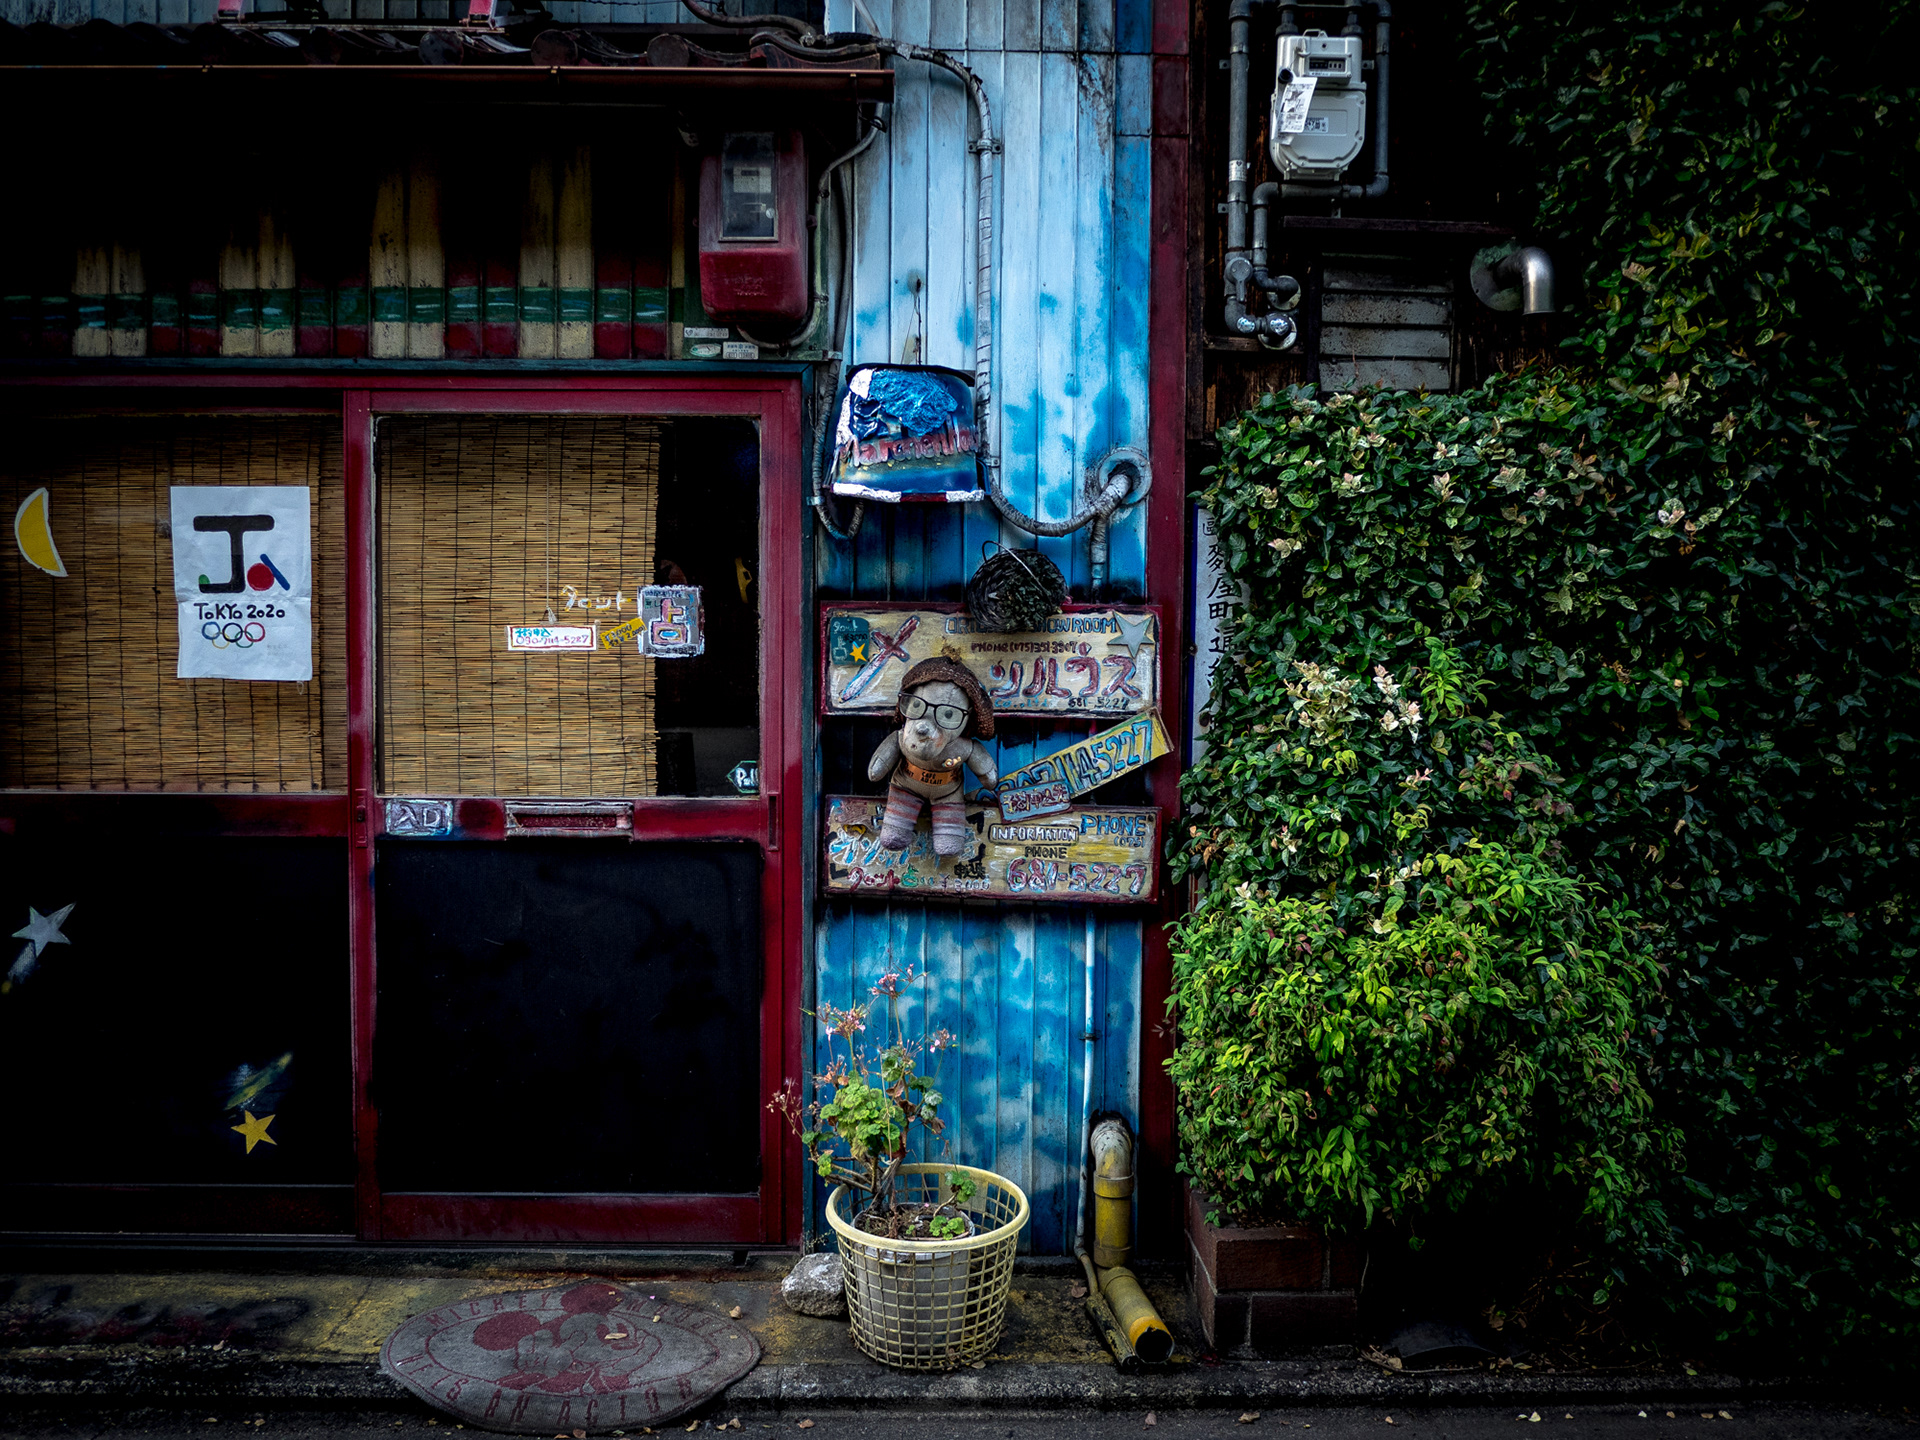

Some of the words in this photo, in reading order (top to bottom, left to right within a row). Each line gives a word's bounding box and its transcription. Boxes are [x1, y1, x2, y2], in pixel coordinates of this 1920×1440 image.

[991, 826, 1077, 843] INFORMATION
[1079, 814, 1146, 837] PHONE
[1025, 845, 1068, 860] PHONE
[1006, 855, 1147, 895] 681-5227
